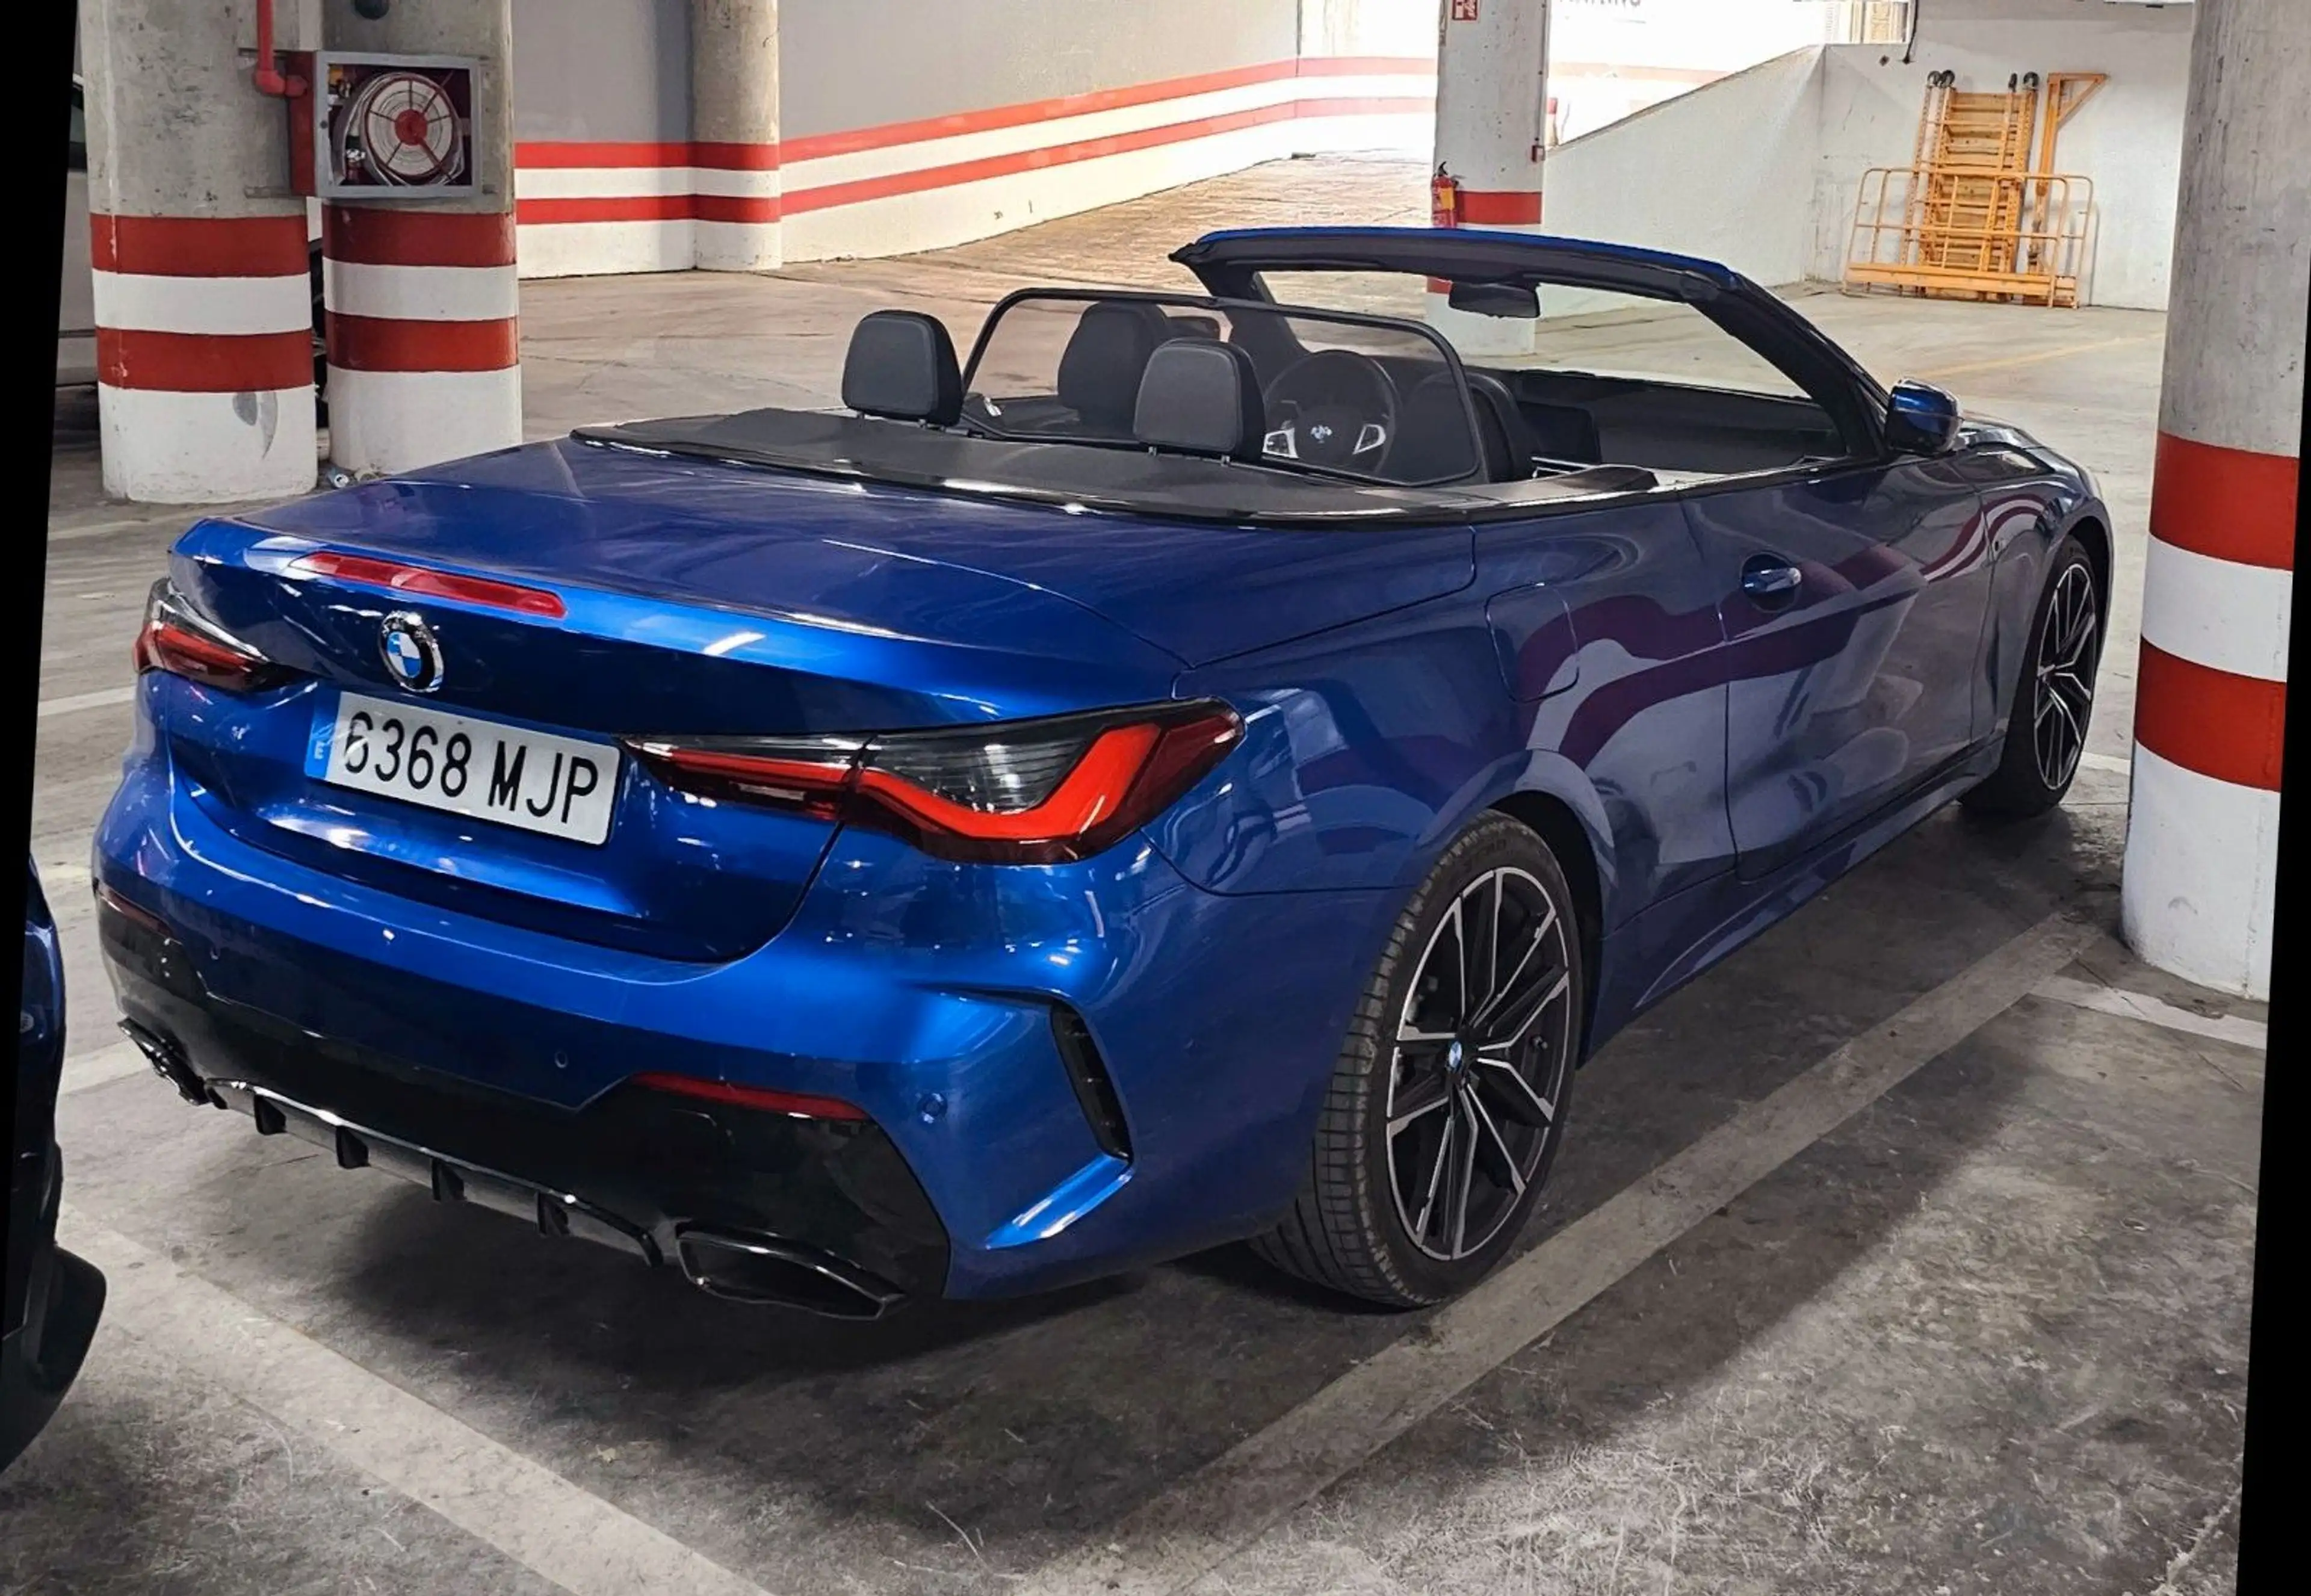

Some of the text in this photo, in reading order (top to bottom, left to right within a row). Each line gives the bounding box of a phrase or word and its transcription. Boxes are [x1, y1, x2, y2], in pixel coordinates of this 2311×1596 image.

[314, 740, 324, 760] E
[345, 711, 598, 824] 6368 MJP
